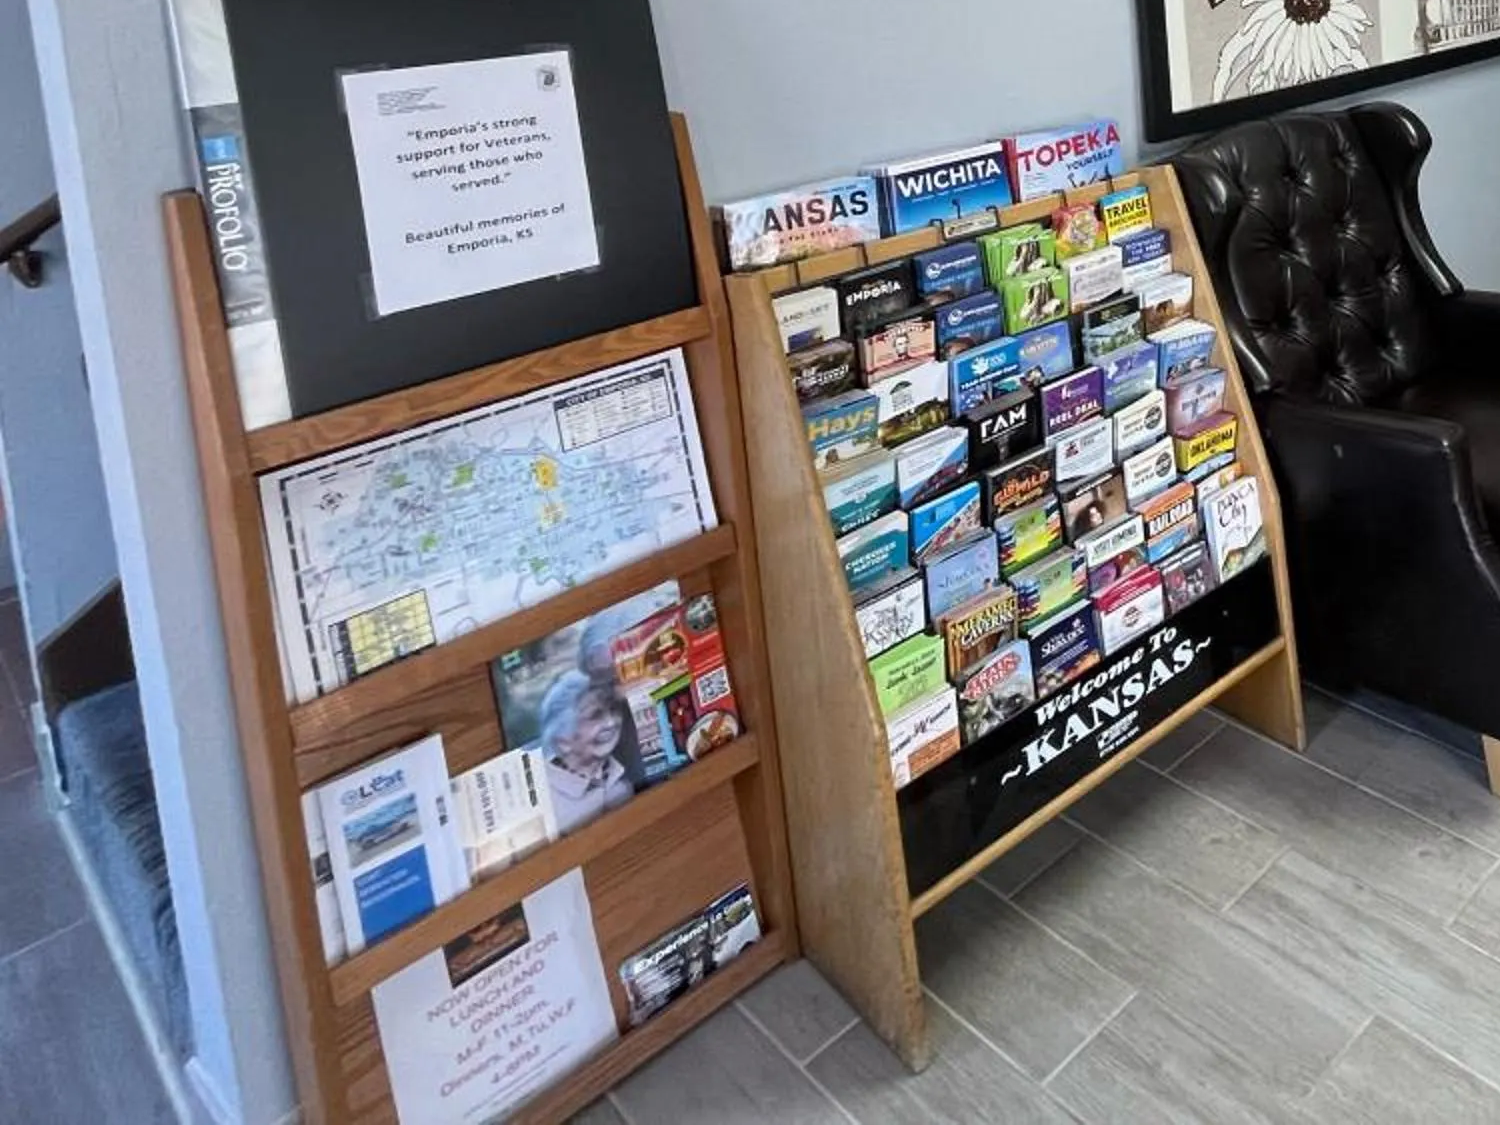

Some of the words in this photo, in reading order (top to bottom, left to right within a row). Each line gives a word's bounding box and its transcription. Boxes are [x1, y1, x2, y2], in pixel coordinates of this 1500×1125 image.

[492, 115, 538, 131] strong
[397, 143, 455, 165] support
[460, 140, 480, 154] for
[411, 161, 467, 181] serving
[469, 154, 510, 171] those
[513, 149, 543, 164] who
[1018, 123, 1121, 172] TOPEKA
[897, 158, 1002, 199] WICHITA
[205, 162, 250, 272] PROFOLIO
[405, 220, 473, 245] Beautiful
[477, 205, 548, 231] memories
[551, 202, 566, 215] of
[762, 189, 870, 233] ANSAS
[1106, 196, 1147, 220] TRAVEL
[516, 227, 535, 241] KS
[845, 280, 902, 306] EMPORIA
[807, 405, 876, 442] Hays
[1033, 646, 1145, 726] Welcome
[1149, 626, 1178, 655] To
[427, 988, 471, 1023] NOW
[474, 955, 521, 992] OPEN
[524, 930, 560, 961] FOR
[450, 982, 509, 1029] LUNCH
[512, 958, 546, 988] AND
[470, 983, 536, 1035] DINNER
